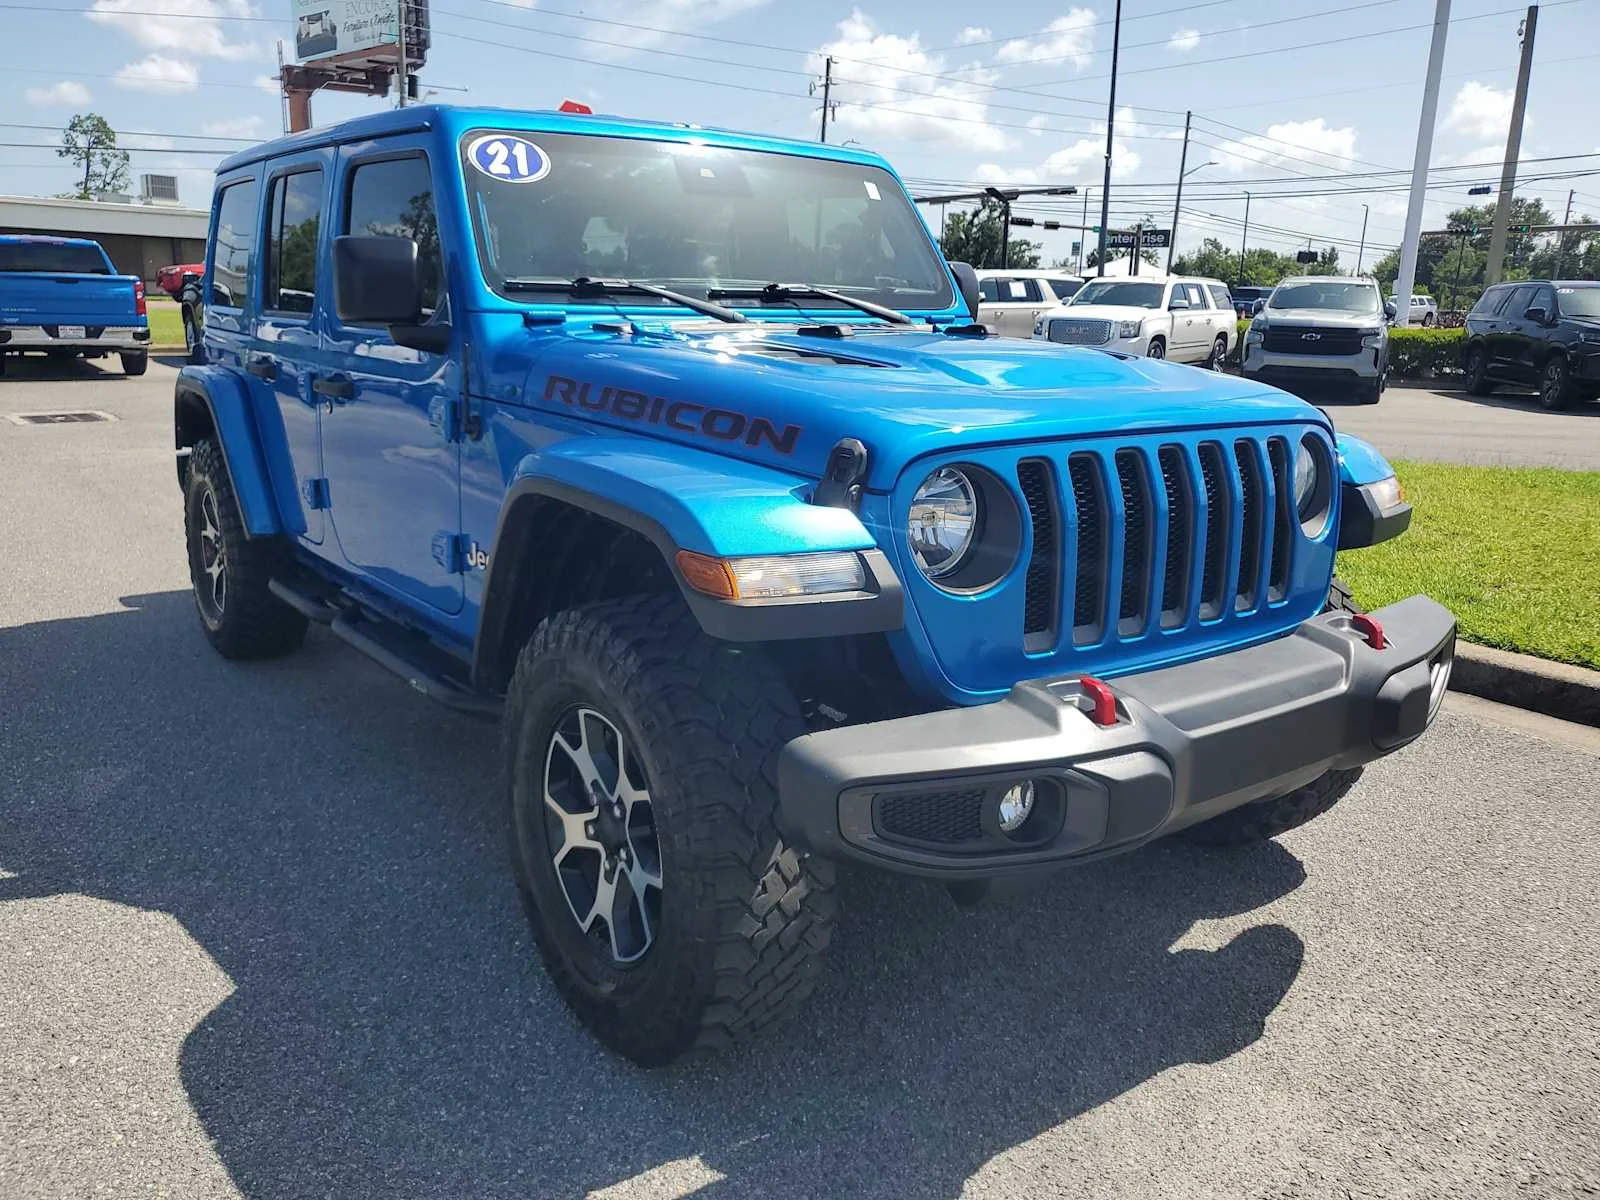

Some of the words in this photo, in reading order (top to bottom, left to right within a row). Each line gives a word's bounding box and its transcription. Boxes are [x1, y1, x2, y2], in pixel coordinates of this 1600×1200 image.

[486, 141, 528, 176] 21
[543, 375, 802, 455] RUBICON
[467, 542, 489, 570] Je
